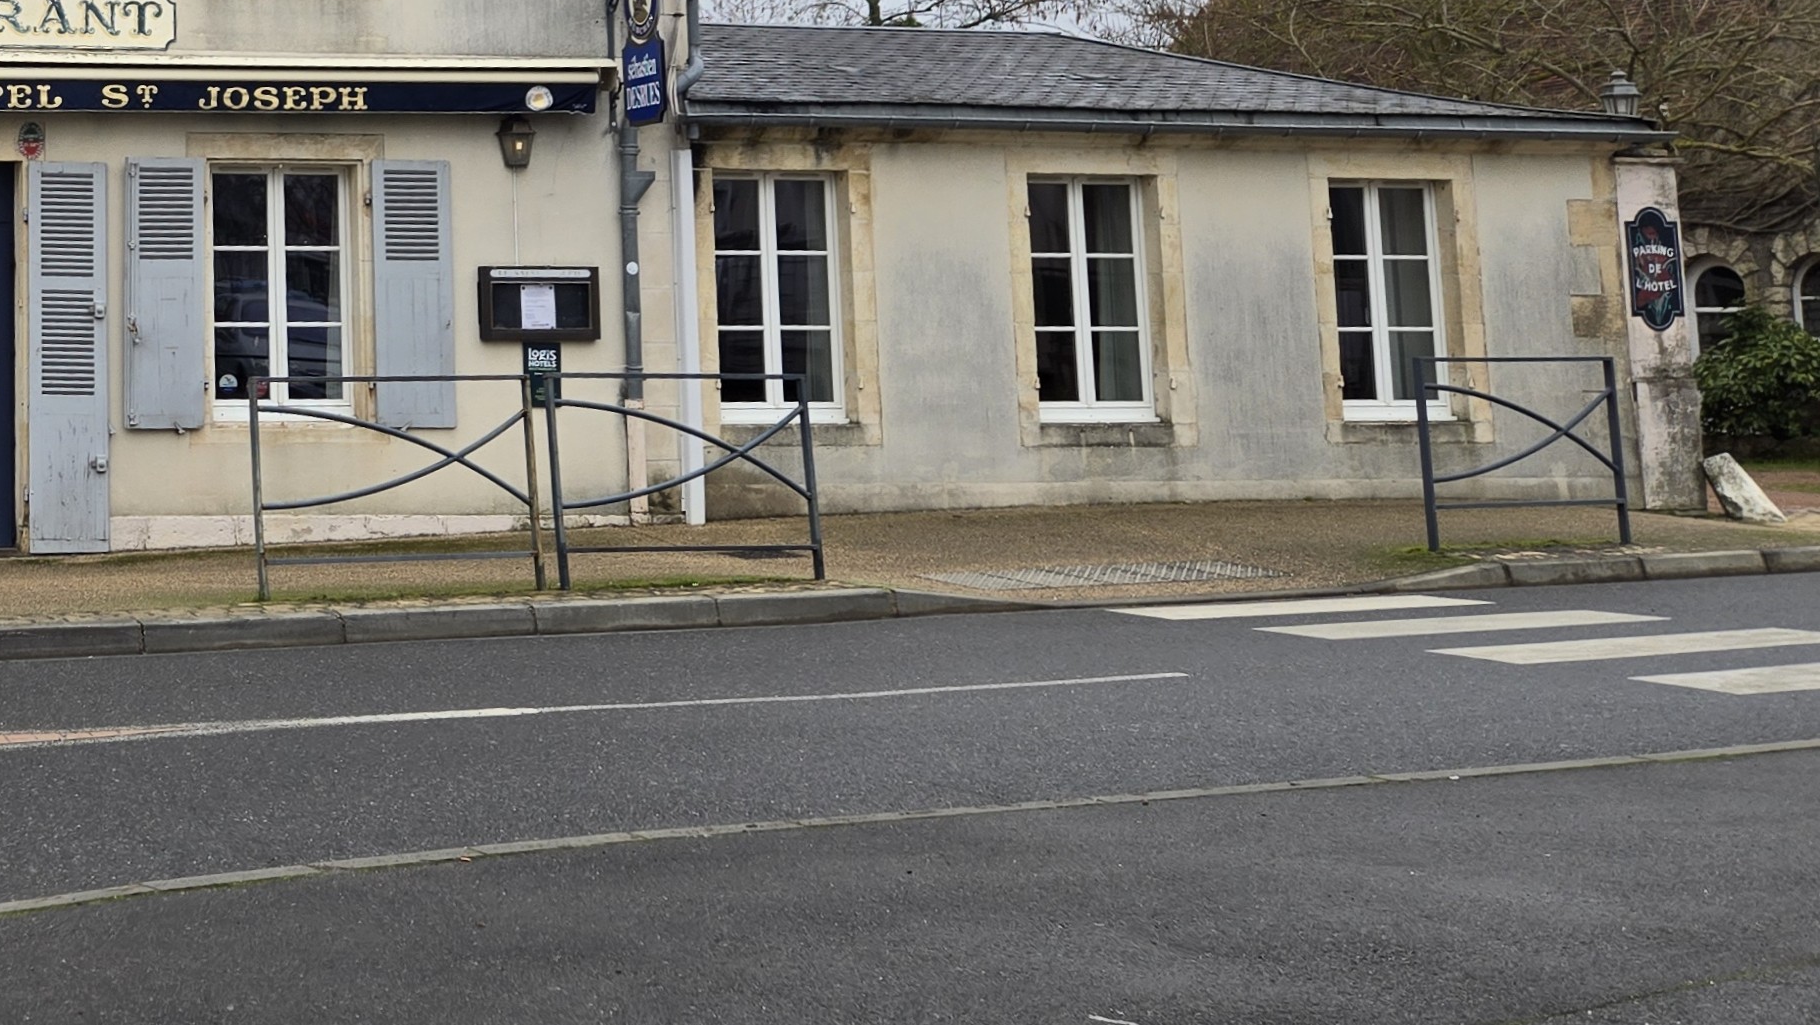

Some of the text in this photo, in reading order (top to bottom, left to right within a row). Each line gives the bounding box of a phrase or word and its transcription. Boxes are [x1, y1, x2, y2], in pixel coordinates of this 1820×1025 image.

[198, 85, 369, 111] JOSEPH
[1632, 244, 1674, 258] PARKING
[1648, 263, 1662, 274] DE
